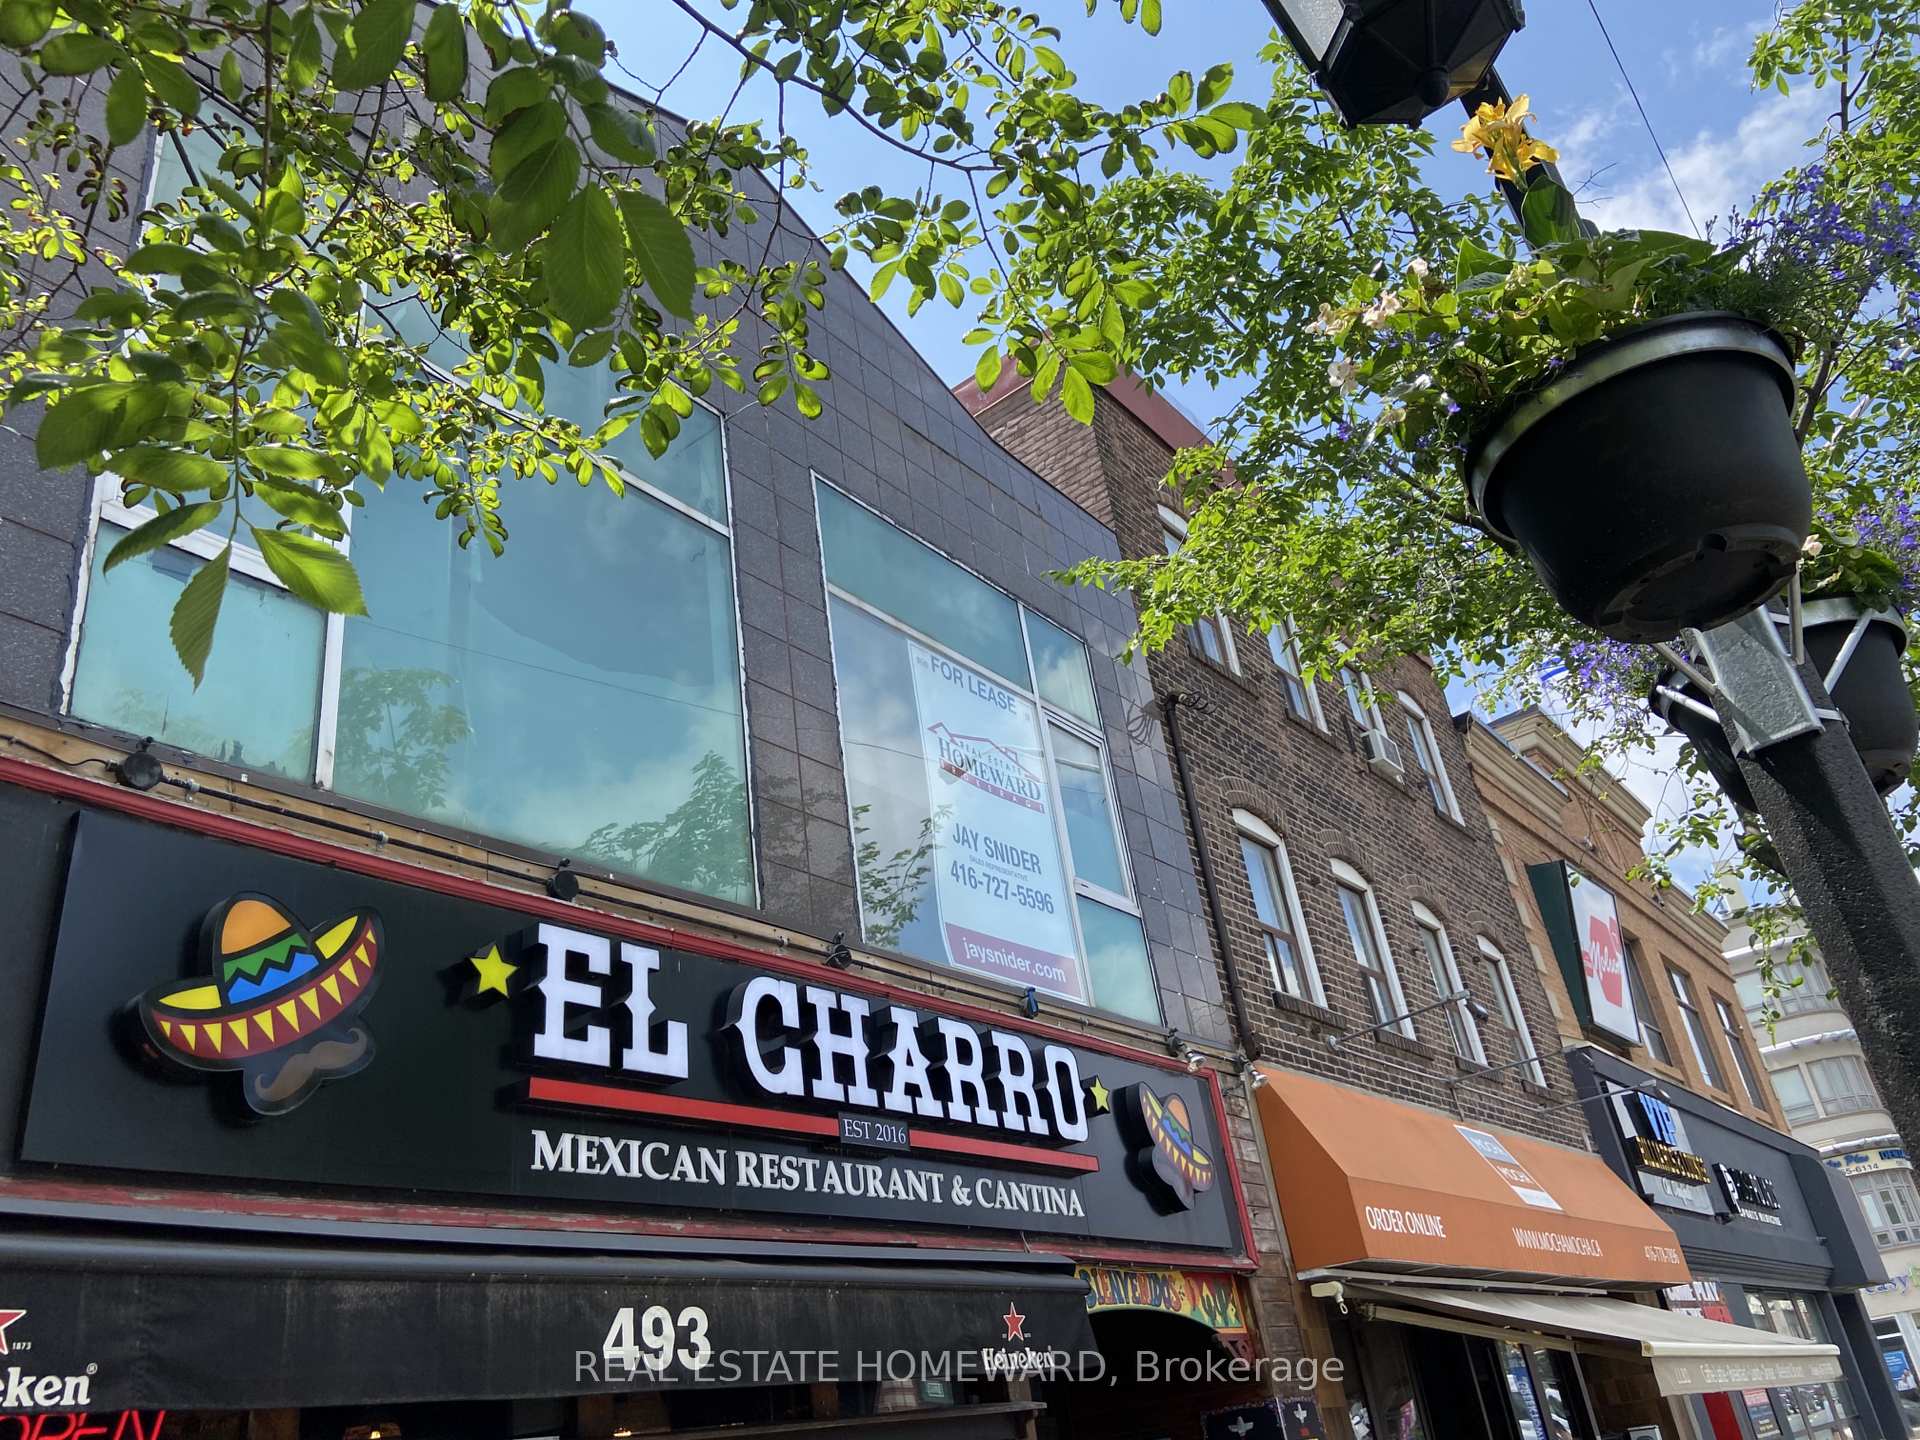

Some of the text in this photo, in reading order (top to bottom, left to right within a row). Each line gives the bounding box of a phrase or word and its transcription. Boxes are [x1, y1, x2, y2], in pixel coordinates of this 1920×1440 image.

[931, 655, 1017, 714] FOR LEASE
[938, 737, 1041, 801] HOMEWARD
[952, 823, 1042, 875] JAY SNIDER
[951, 860, 1054, 914] 416-727-5596
[962, 936, 1066, 982] jaysnider.com
[533, 922, 1088, 1142] EL CHARRO
[842, 1118, 907, 1144] EST 2016
[531, 1129, 1086, 1217] MEXICAN RESTAURANT & CANTINA
[1365, 1206, 1447, 1238] ORDER ONLINE
[12, 1341, 32, 1350] 1873
[602, 1305, 712, 1371] 493
[982, 1347, 1054, 1370] Heineken
